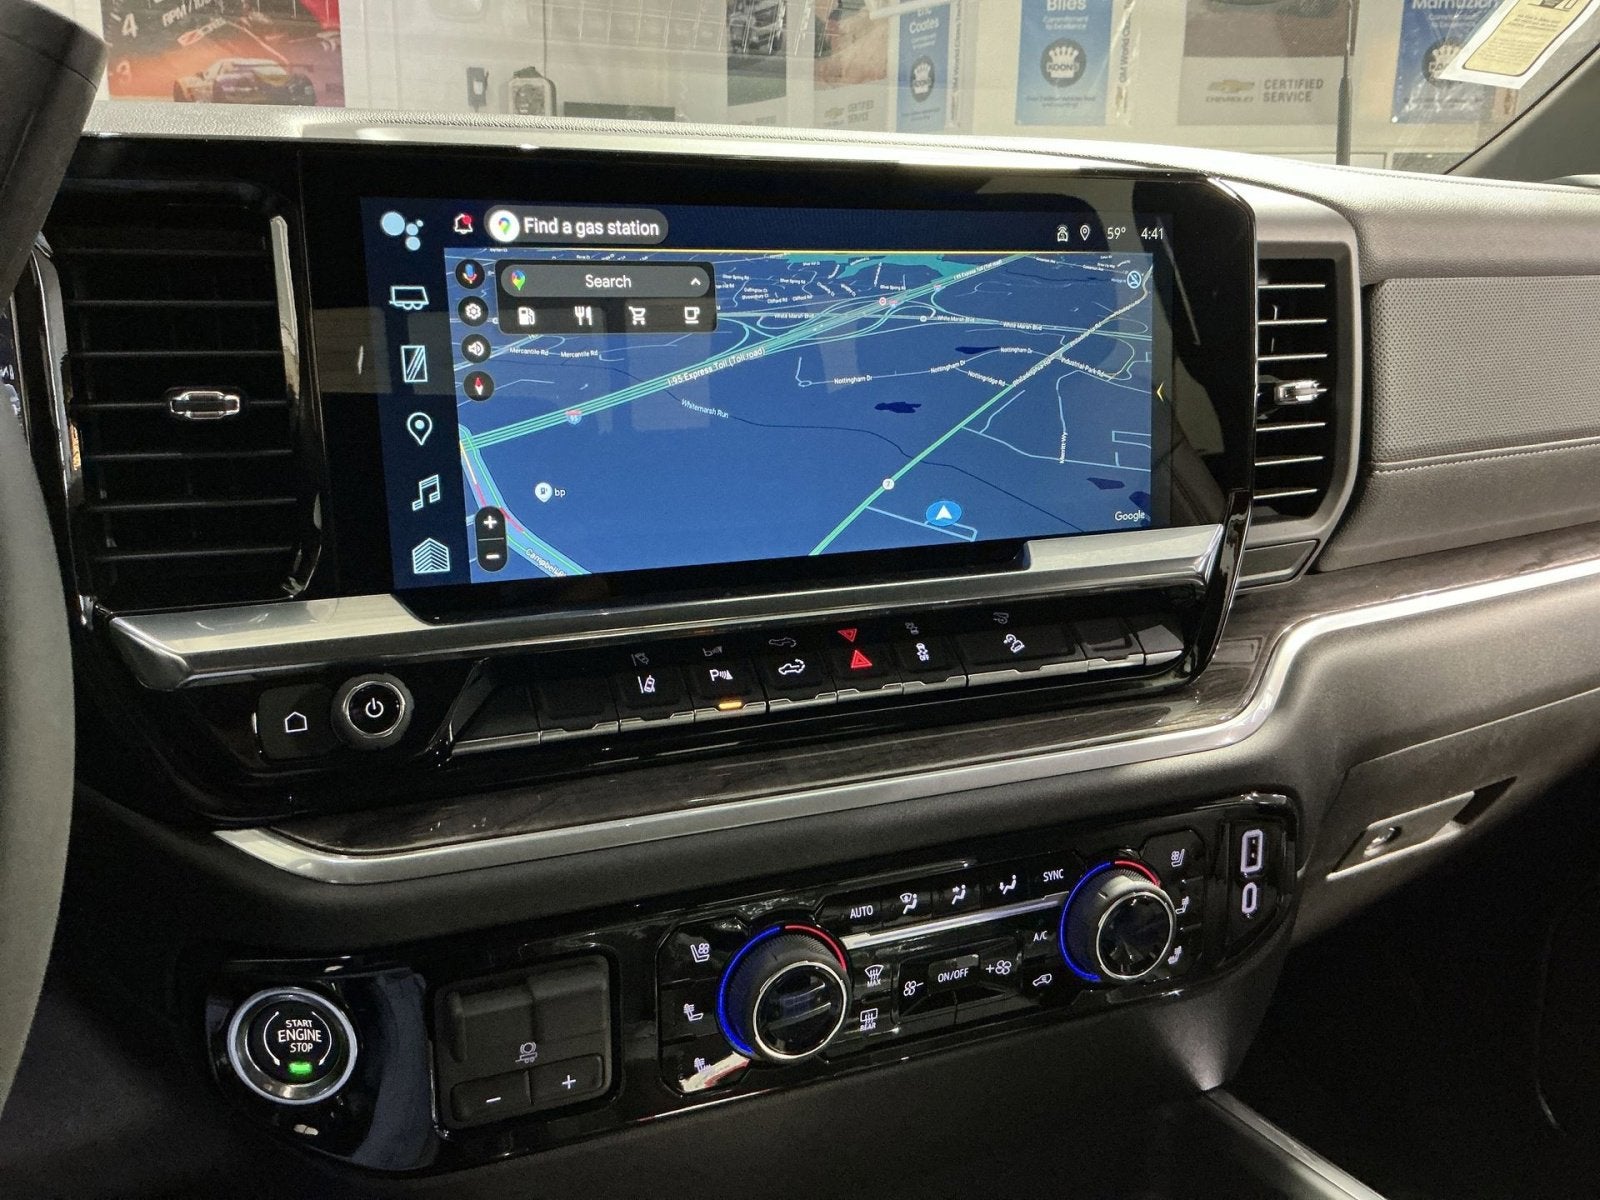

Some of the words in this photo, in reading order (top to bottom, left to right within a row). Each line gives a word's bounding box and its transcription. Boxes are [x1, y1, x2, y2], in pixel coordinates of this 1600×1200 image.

[1263, 79, 1324, 90] CERTIFIED
[1263, 91, 1312, 102] SERVICE
[523, 216, 559, 234] Find
[562, 221, 573, 234] a
[575, 221, 604, 238] gas
[607, 220, 659, 236] station
[1141, 227, 1164, 240] 4:41
[585, 274, 632, 288] Search
[510, 347, 539, 355] Mercantile
[684, 366, 713, 380] Express
[714, 361, 727, 370] Toll
[930, 362, 959, 373] Nottingham
[834, 376, 866, 385] Nottingham
[866, 374, 873, 382] Dr
[681, 398, 717, 416] Whitemarsh
[717, 409, 729, 419] Run
[554, 488, 567, 498] bp
[1114, 510, 1145, 522] Google
[1043, 868, 1064, 883] SYNC
[850, 904, 874, 919] AUTO
[1033, 930, 1048, 943] A/C
[937, 967, 970, 984] ON/OFF
[867, 979, 882, 988] MAX
[285, 1019, 313, 1028] START
[277, 1028, 323, 1043] ENGINE
[290, 1042, 314, 1053] STOP
